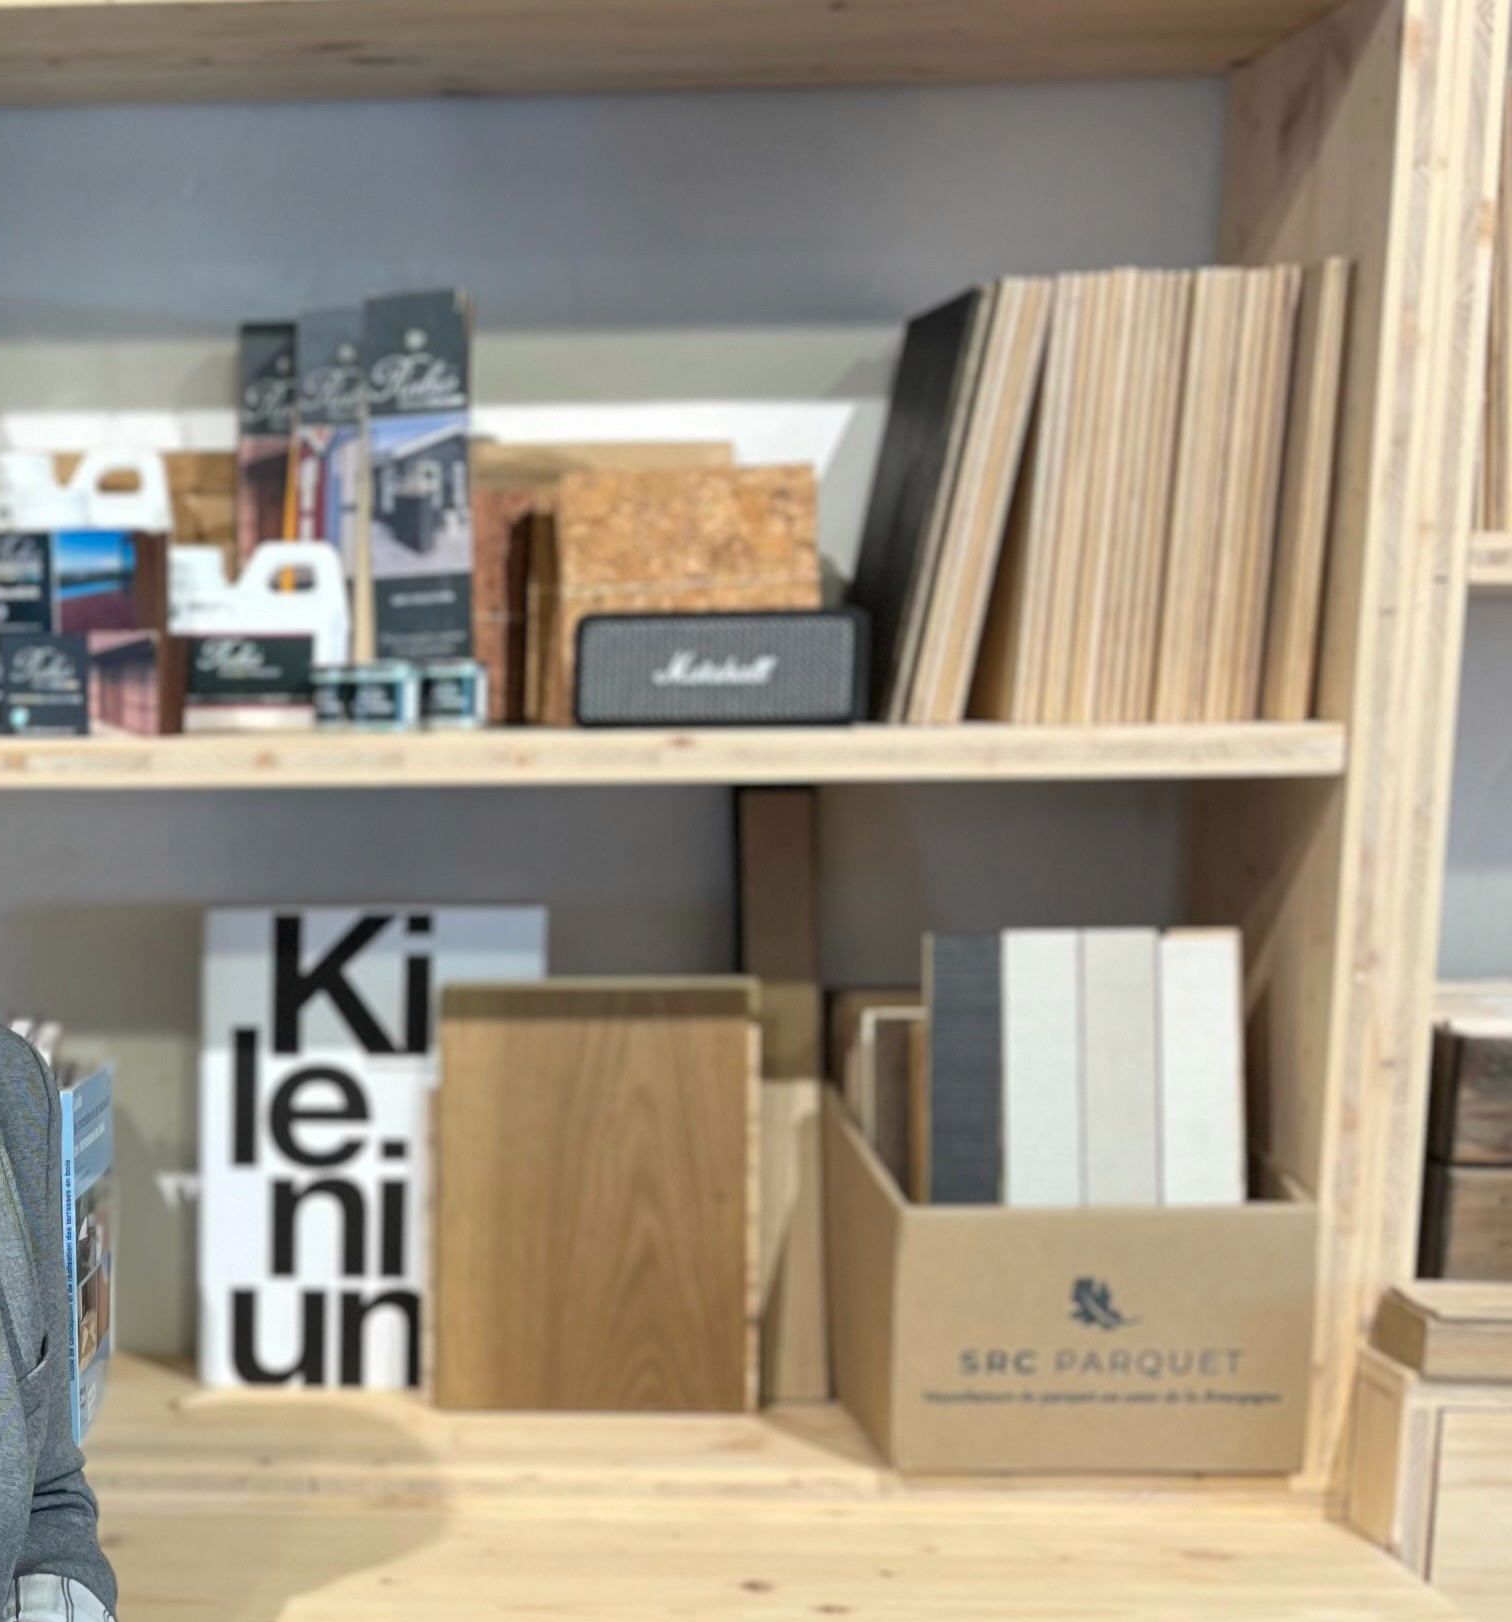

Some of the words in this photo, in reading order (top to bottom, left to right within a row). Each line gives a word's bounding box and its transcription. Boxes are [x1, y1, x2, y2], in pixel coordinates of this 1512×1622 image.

[273, 914, 431, 1054] Ki
[273, 1141, 405, 1277] ni
[959, 1349, 1036, 1376] SRC
[1054, 1348, 1244, 1380] PARQUET
